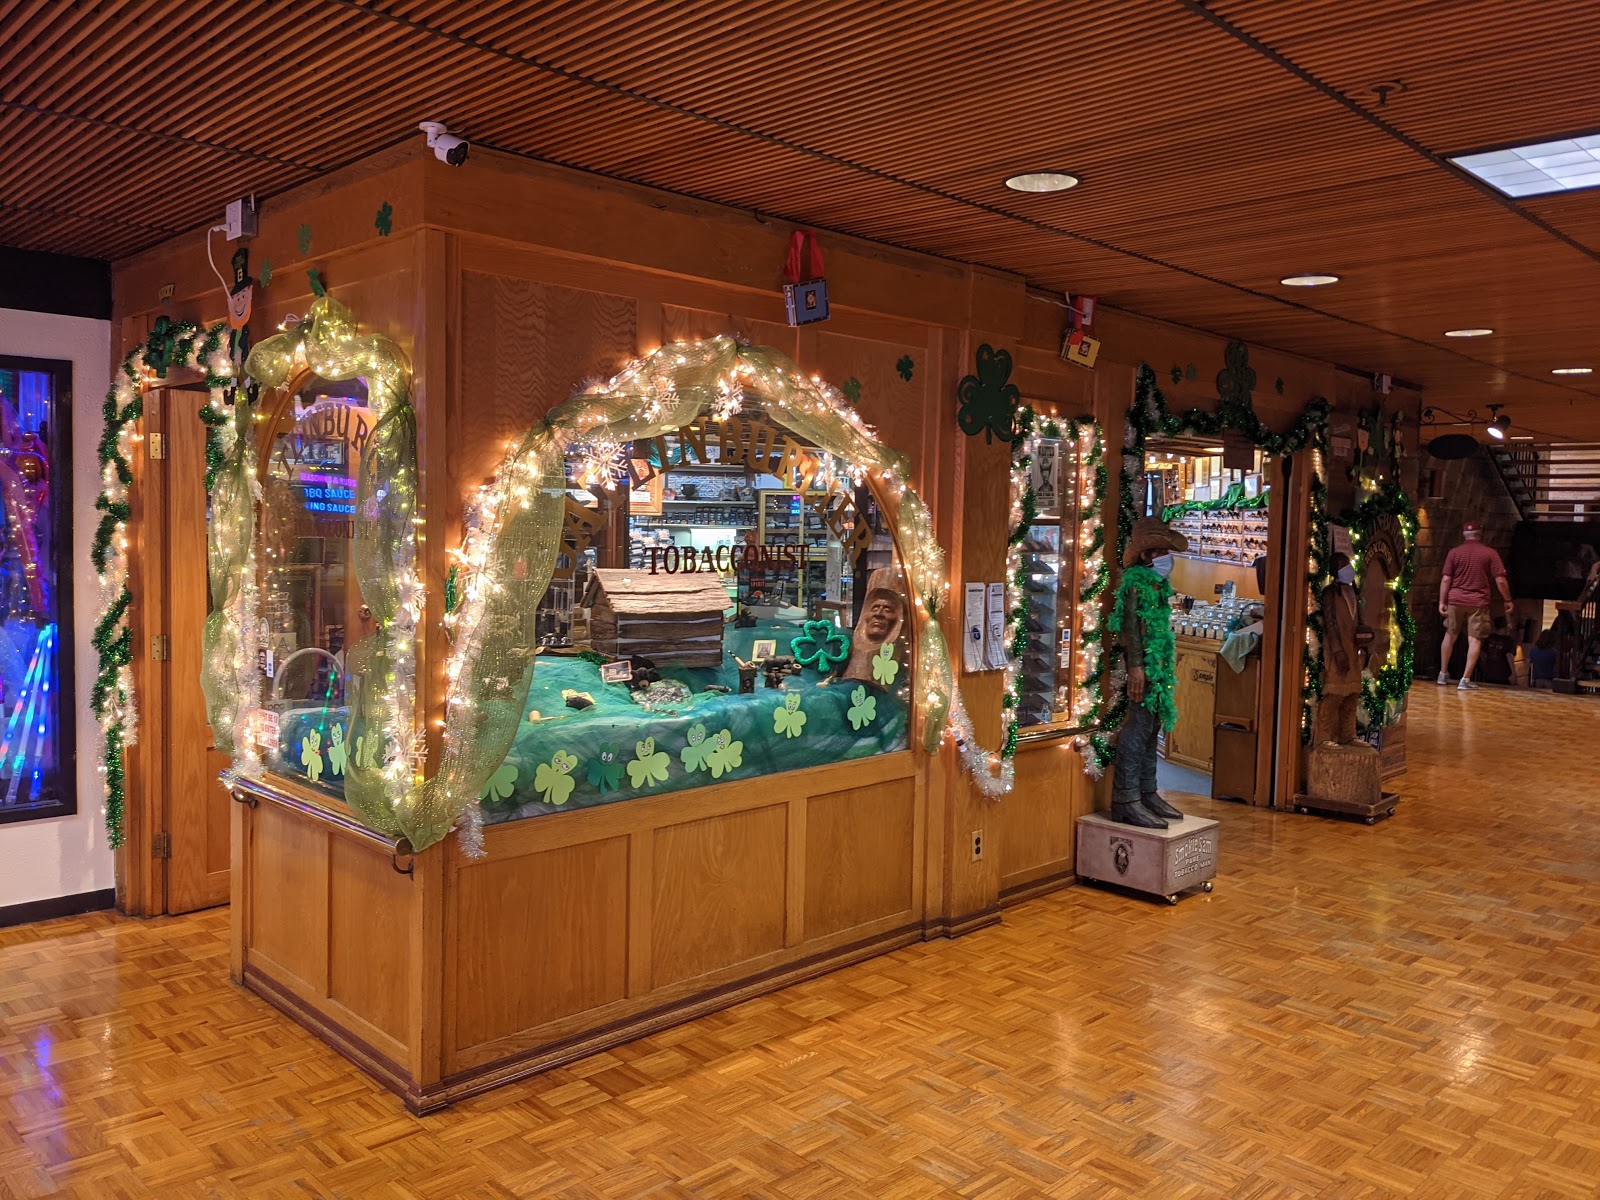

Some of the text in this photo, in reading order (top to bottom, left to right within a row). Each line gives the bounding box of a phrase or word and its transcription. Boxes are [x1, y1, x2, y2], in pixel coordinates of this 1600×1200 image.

[324, 488, 356, 499] SAUCE
[304, 502, 356, 514] ING SAUCE
[645, 544, 810, 575] TOBACCONIST
[1175, 836, 1212, 864] Smokie Sam
